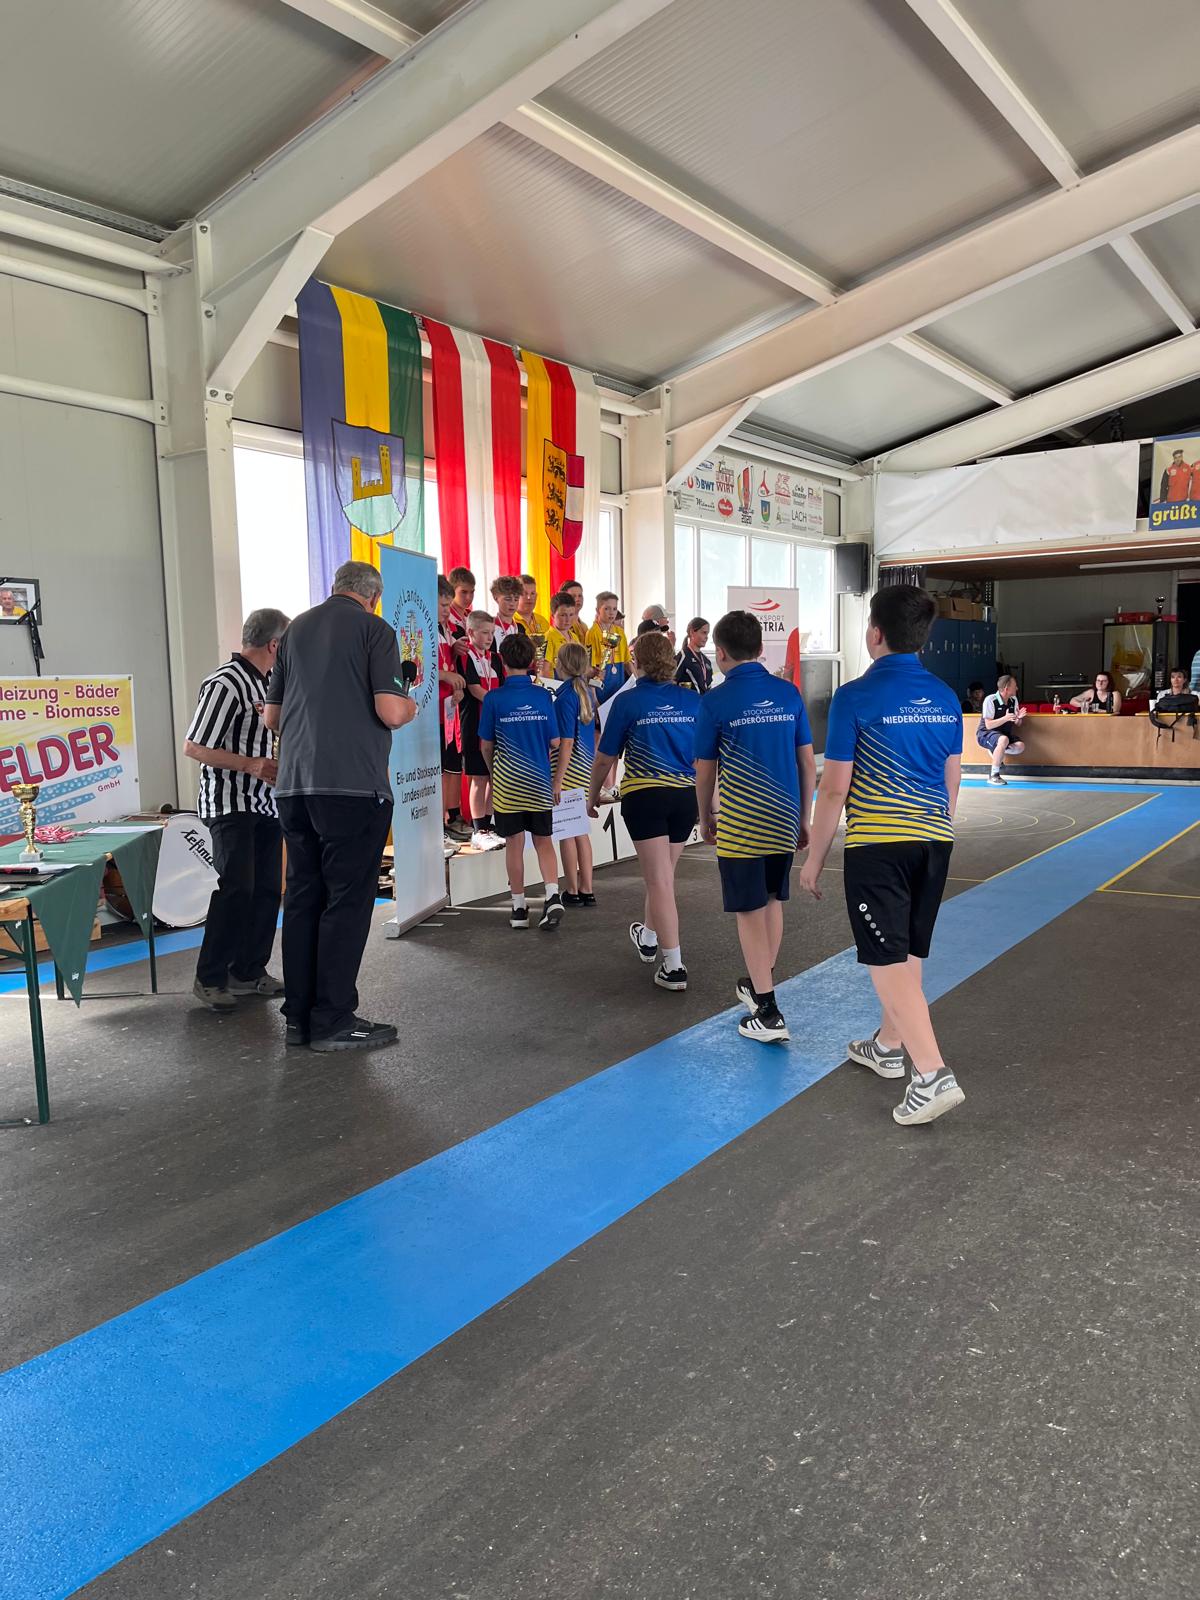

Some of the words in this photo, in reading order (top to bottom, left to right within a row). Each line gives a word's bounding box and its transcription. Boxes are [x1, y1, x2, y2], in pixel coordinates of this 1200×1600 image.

[700, 479, 714, 491] BWT
[791, 510, 807, 523] LACH
[1152, 504, 1197, 526] grüßt
[760, 621, 785, 632] TRIA
[0, 686, 59, 703] eizung
[75, 684, 120, 699] Bäder
[45, 704, 120, 719] Biomasse
[743, 707, 784, 717] STOCKSPORT
[899, 706, 943, 714] STOCKSPORT
[729, 714, 795, 728] NIEDERÖSTERREIC
[405, 768, 417, 783] und
[97, 780, 121, 792] GmbH
[602, 806, 618, 861] 1
[692, 828, 698, 841] 3
